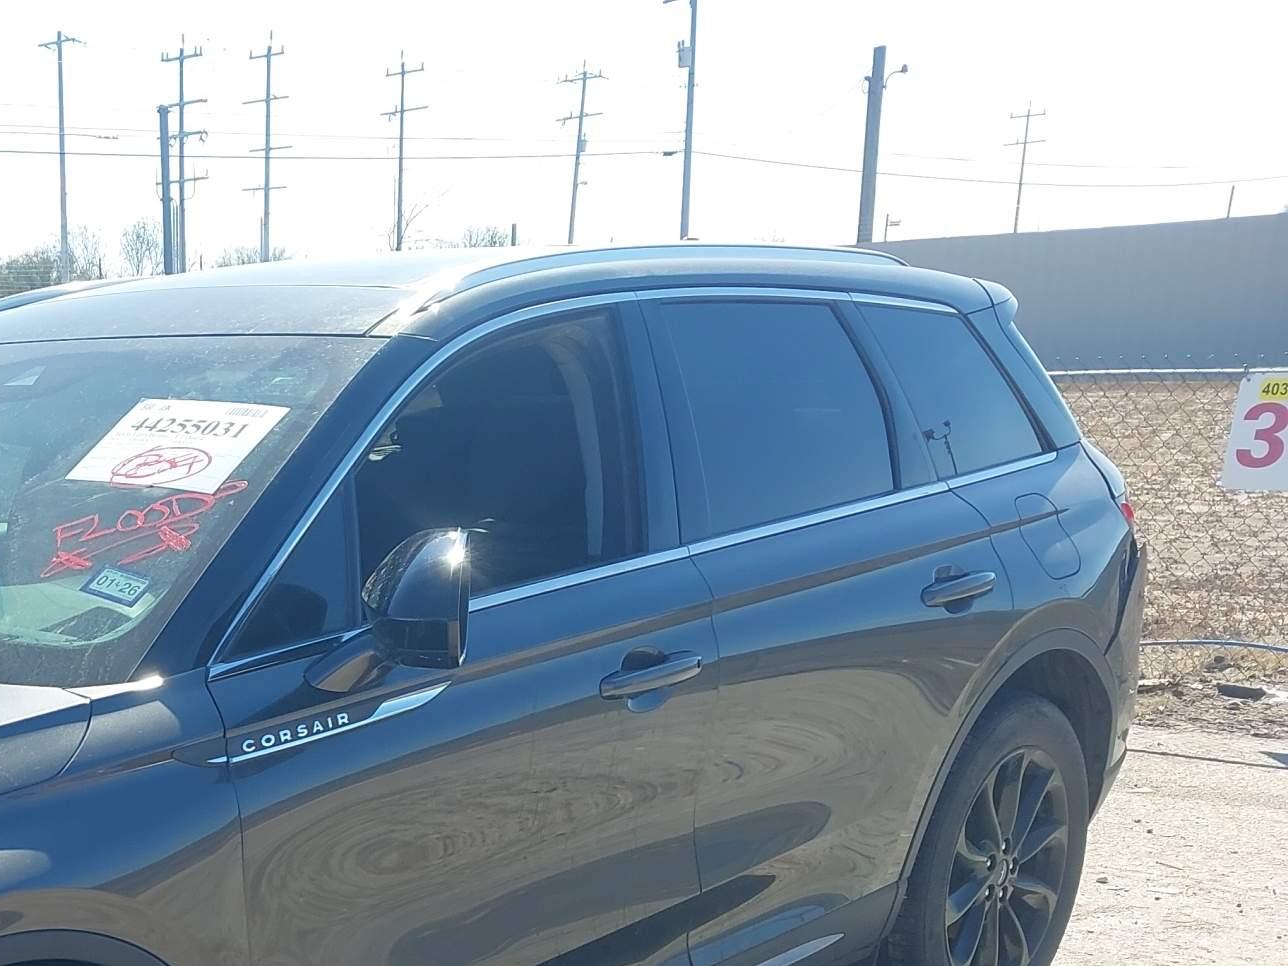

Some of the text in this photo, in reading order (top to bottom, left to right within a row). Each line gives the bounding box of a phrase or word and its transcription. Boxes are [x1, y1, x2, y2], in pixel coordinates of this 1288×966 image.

[1261, 382, 1288, 396] 403
[130, 416, 249, 439] 44255031
[1235, 401, 1288, 469] 3
[242, 712, 350, 753] CORSAIR
